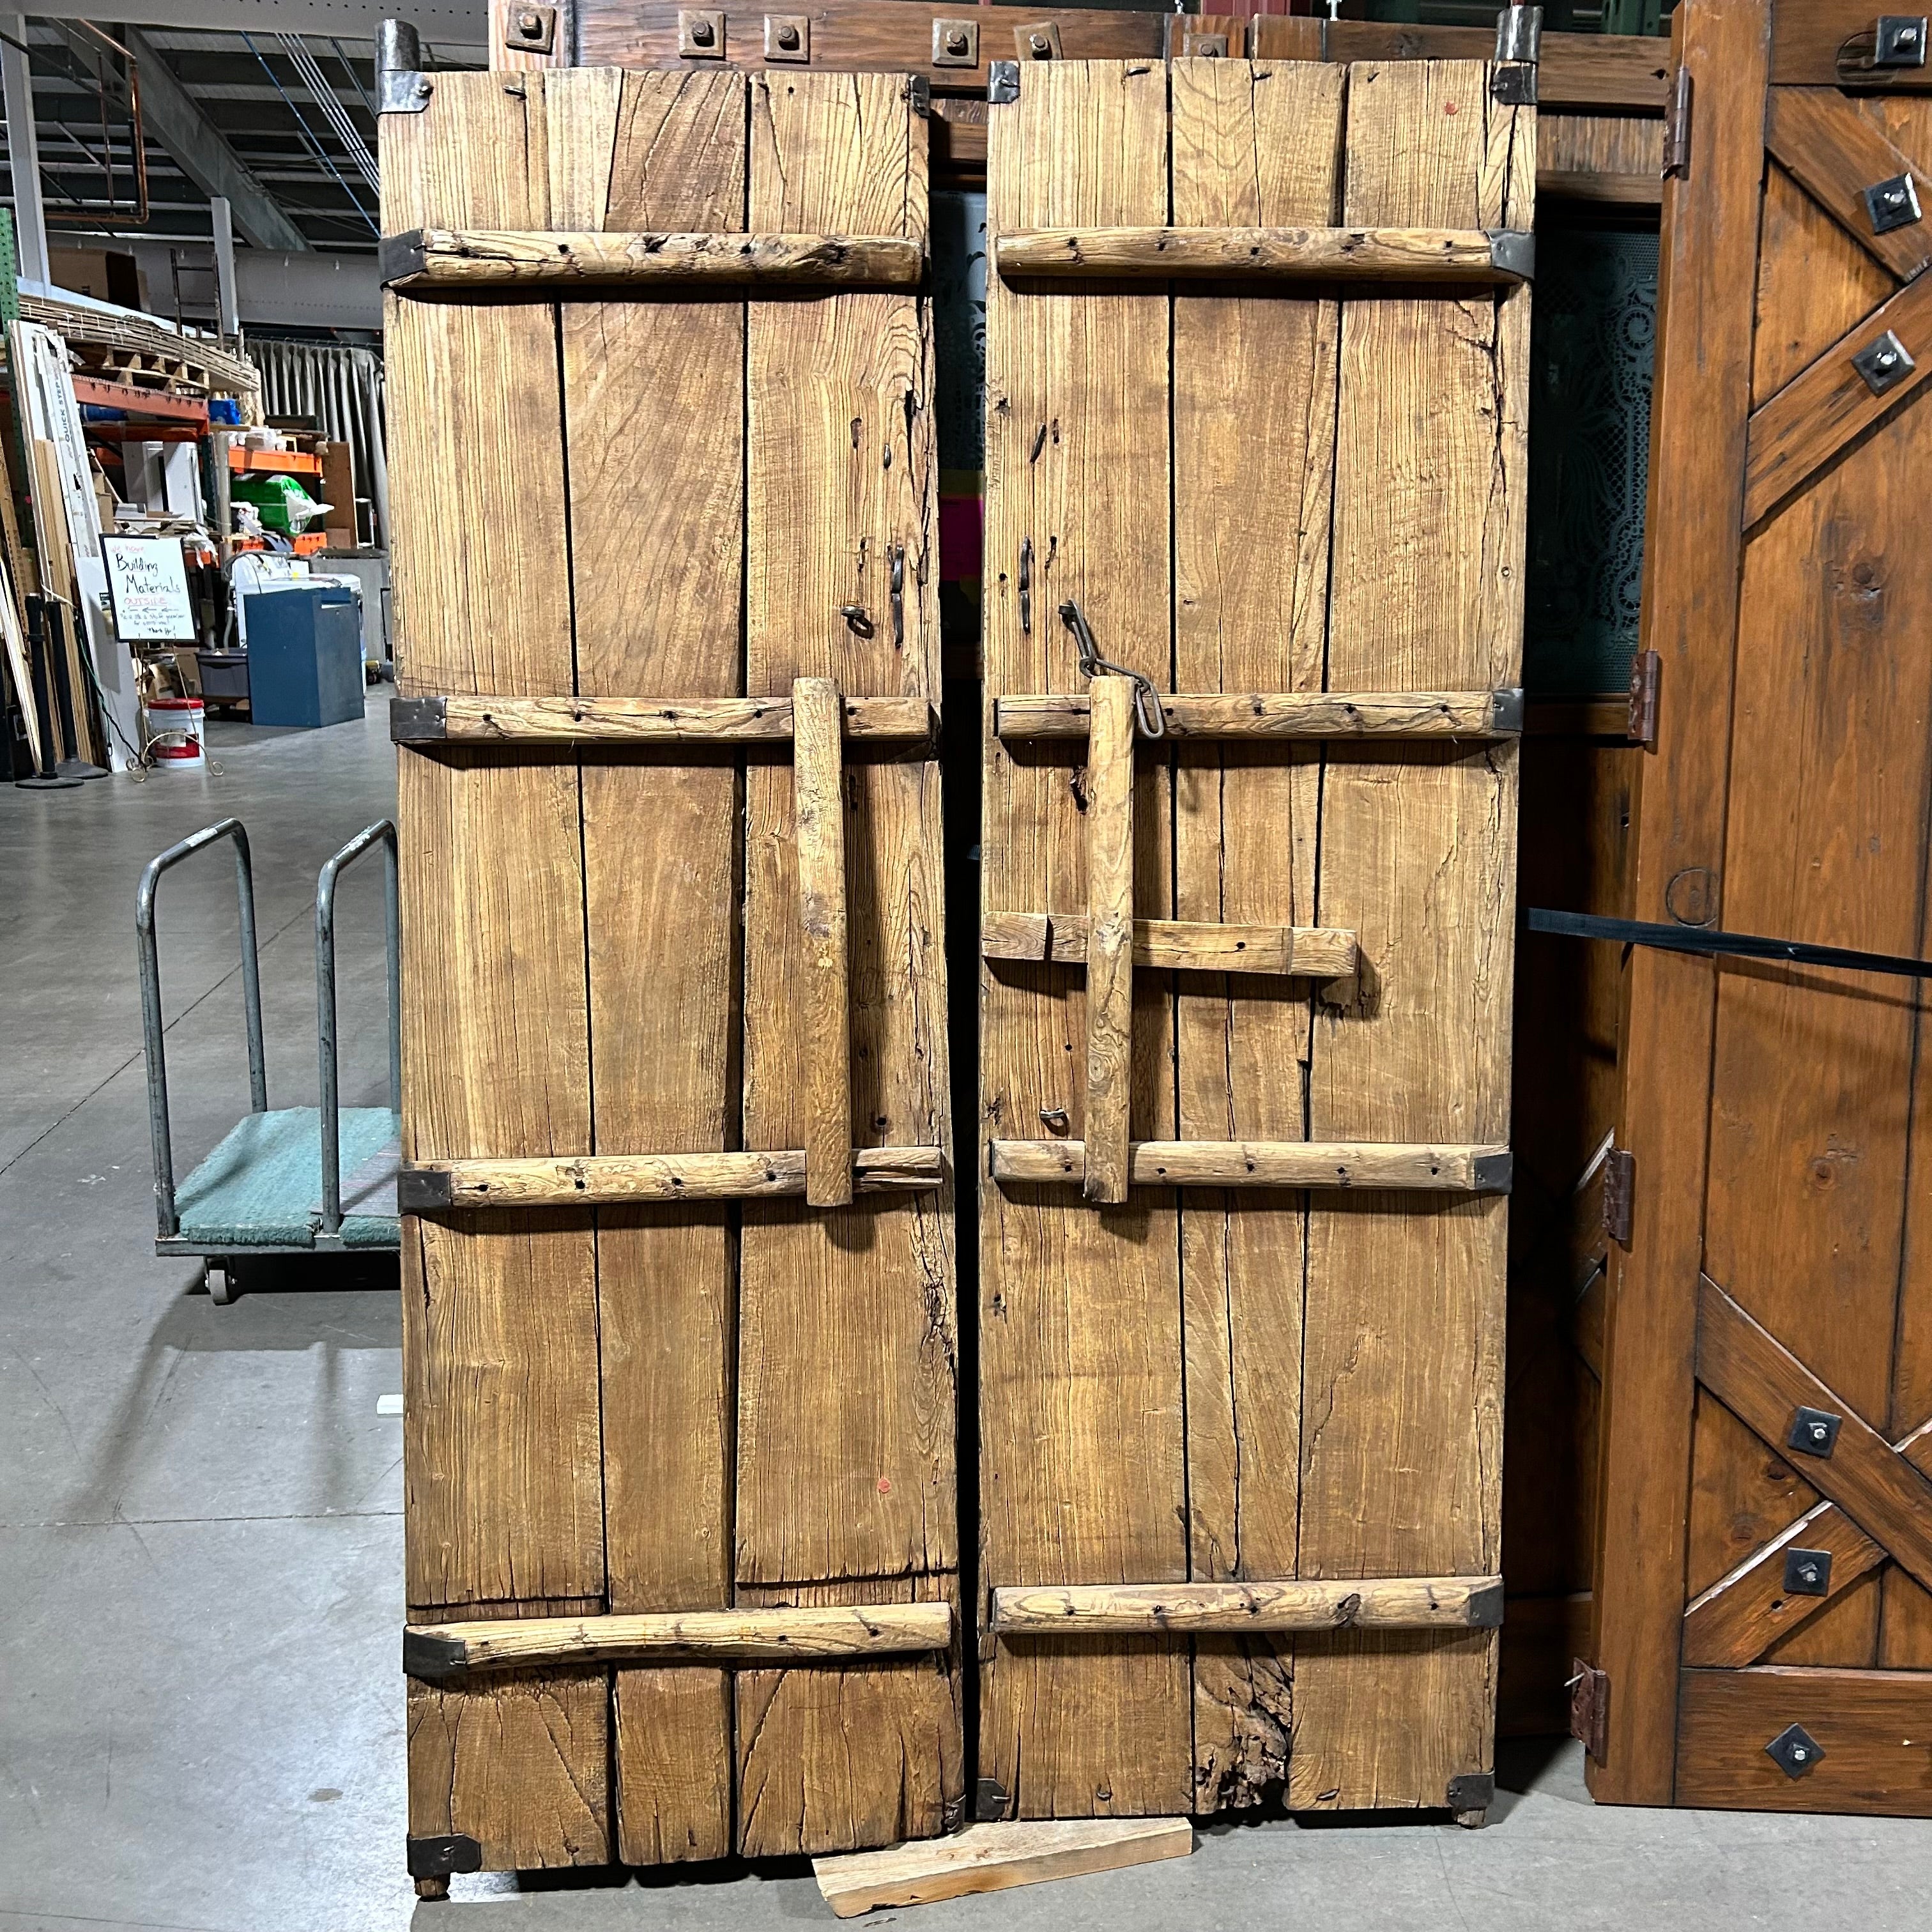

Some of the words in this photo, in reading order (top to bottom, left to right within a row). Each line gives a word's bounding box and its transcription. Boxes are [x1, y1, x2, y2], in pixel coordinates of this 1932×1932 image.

[56, 381, 64, 405] STEP
[60, 409, 70, 443] QUICK
[116, 553, 158, 577] Building
[126, 574, 180, 594] Materials
